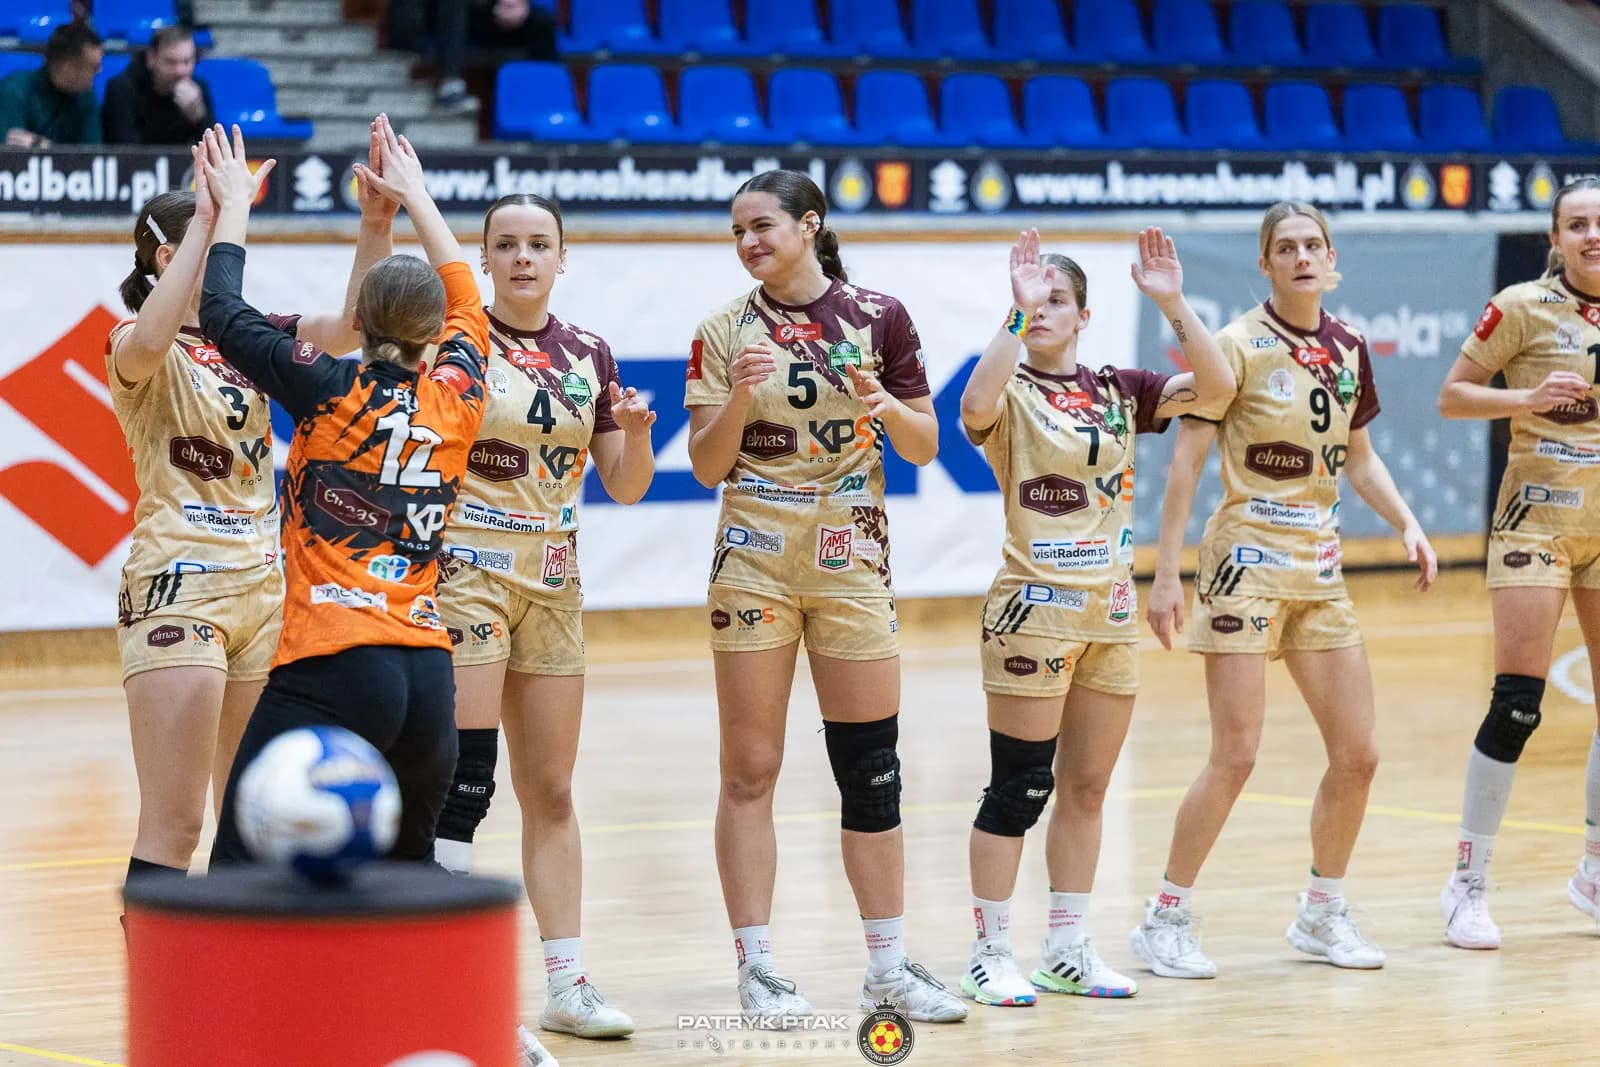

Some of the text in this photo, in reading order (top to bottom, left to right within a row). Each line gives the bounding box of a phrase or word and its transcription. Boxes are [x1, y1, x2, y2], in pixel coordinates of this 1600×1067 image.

[1015, 160, 1395, 211] www.koronahandball.pl
[1251, 337, 1278, 348] TICO
[1587, 343, 1600, 384] 1
[787, 362, 818, 410] 5
[218, 386, 249, 431] 3
[527, 389, 556, 434] 4
[1309, 388, 1331, 433] 9
[1553, 402, 1590, 414] mas
[746, 429, 787, 448] elmas
[809, 415, 875, 455] KPS
[1074, 426, 1099, 466] 7
[376, 412, 443, 487] 12
[470, 448, 519, 469] elmas
[538, 445, 588, 480] KPS
[1255, 448, 1304, 468] elmas
[1319, 445, 1348, 478] KP
[1029, 483, 1079, 501] elmas
[324, 489, 378, 526] eas
[464, 509, 545, 533] visitRadom.pl
[1033, 546, 1109, 561] visitRadom.pl
[469, 620, 503, 641] KPS
[736, 607, 776, 627] KPS
[152, 628, 179, 642] elmas
[1008, 655, 1072, 675] elmas KPS
